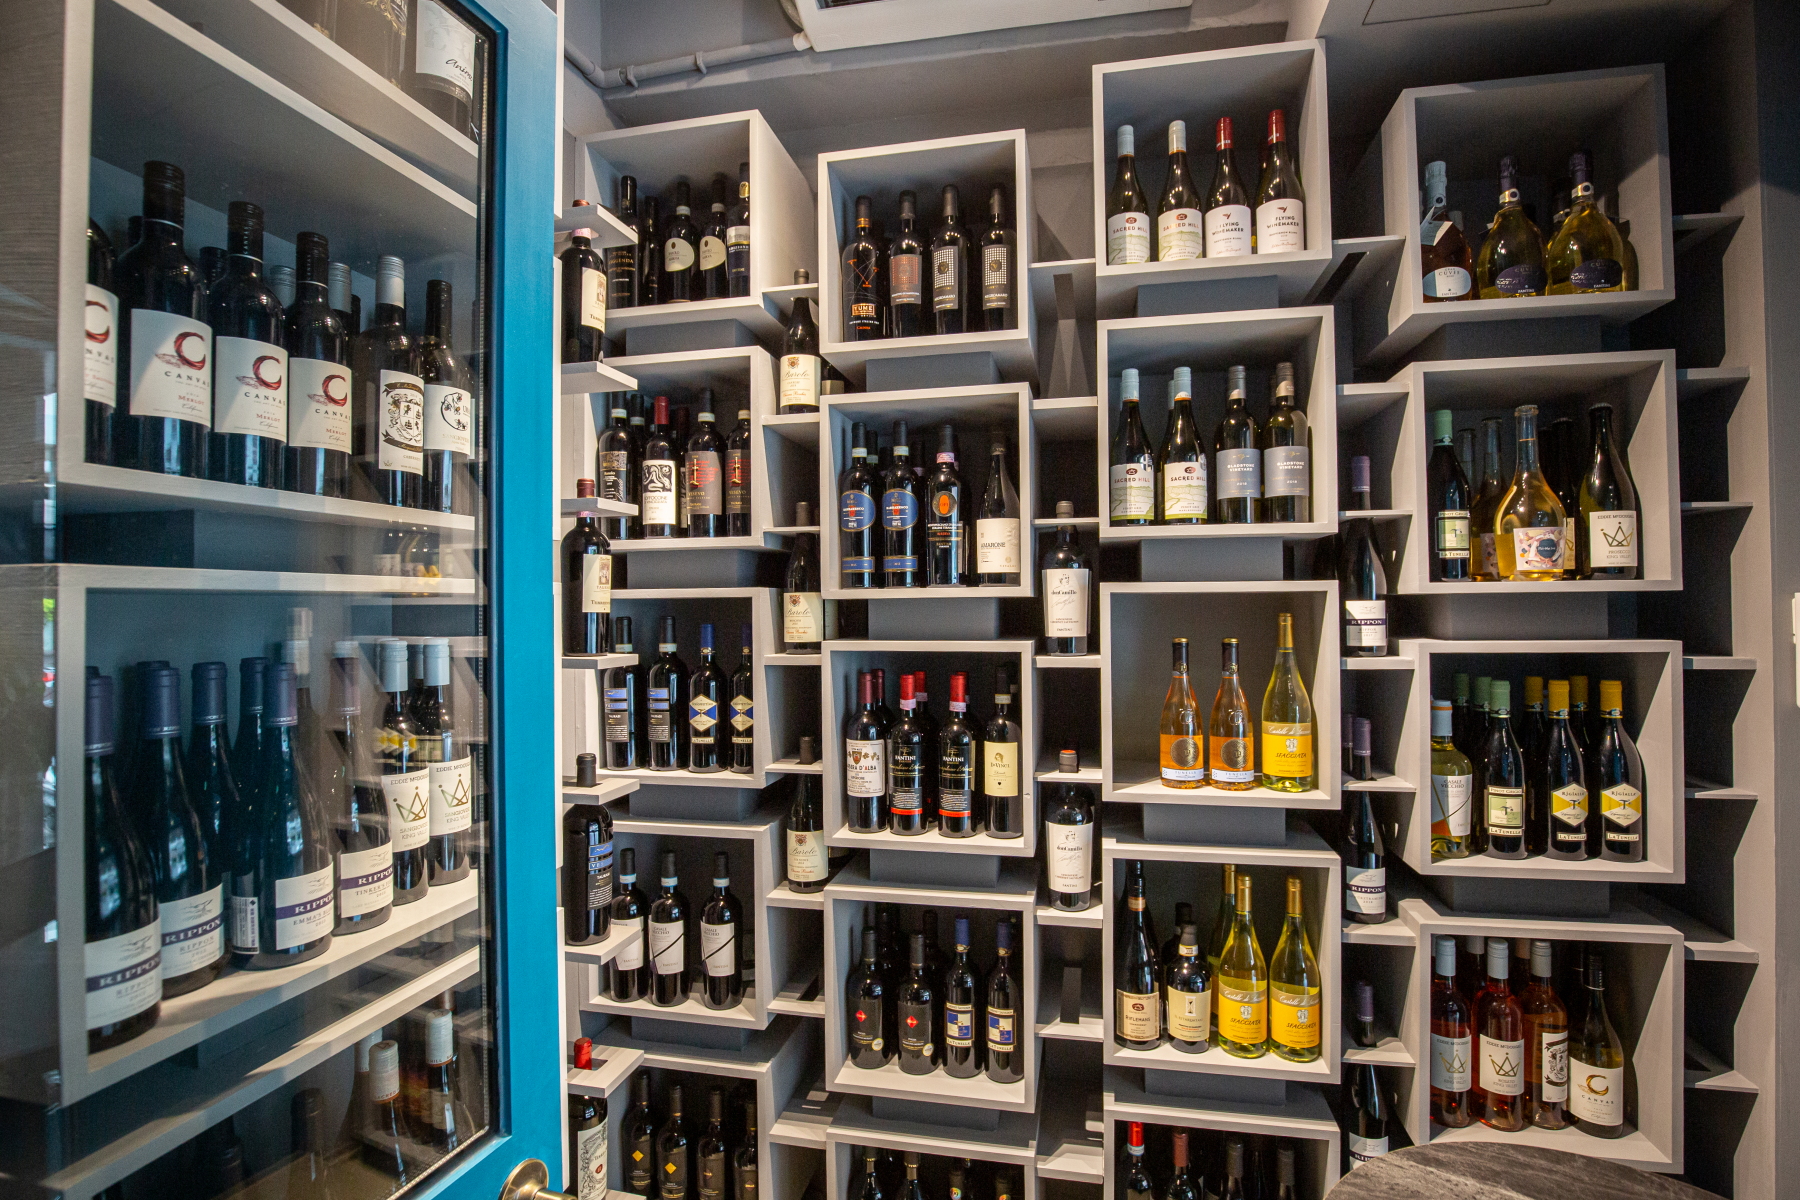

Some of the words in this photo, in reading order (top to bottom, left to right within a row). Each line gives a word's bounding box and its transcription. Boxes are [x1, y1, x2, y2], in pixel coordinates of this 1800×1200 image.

[1113, 226, 1135, 234] SACRED
[1163, 223, 1186, 231] SACRED
[1212, 228, 1244, 236] WINEMAKER
[164, 371, 210, 386] CANVAS
[244, 392, 286, 406] CANVAS
[315, 408, 350, 420] CANVAS
[791, 847, 817, 855] Barolo
[358, 866, 393, 885] RIPPON
[355, 884, 385, 896] TINKER'S
[295, 894, 334, 914] RIPPON
[293, 913, 322, 926] EMMA'S
[165, 918, 221, 943] RIPPON
[100, 956, 161, 987] RIPPON
[1582, 1094, 1614, 1104] CANVAS
